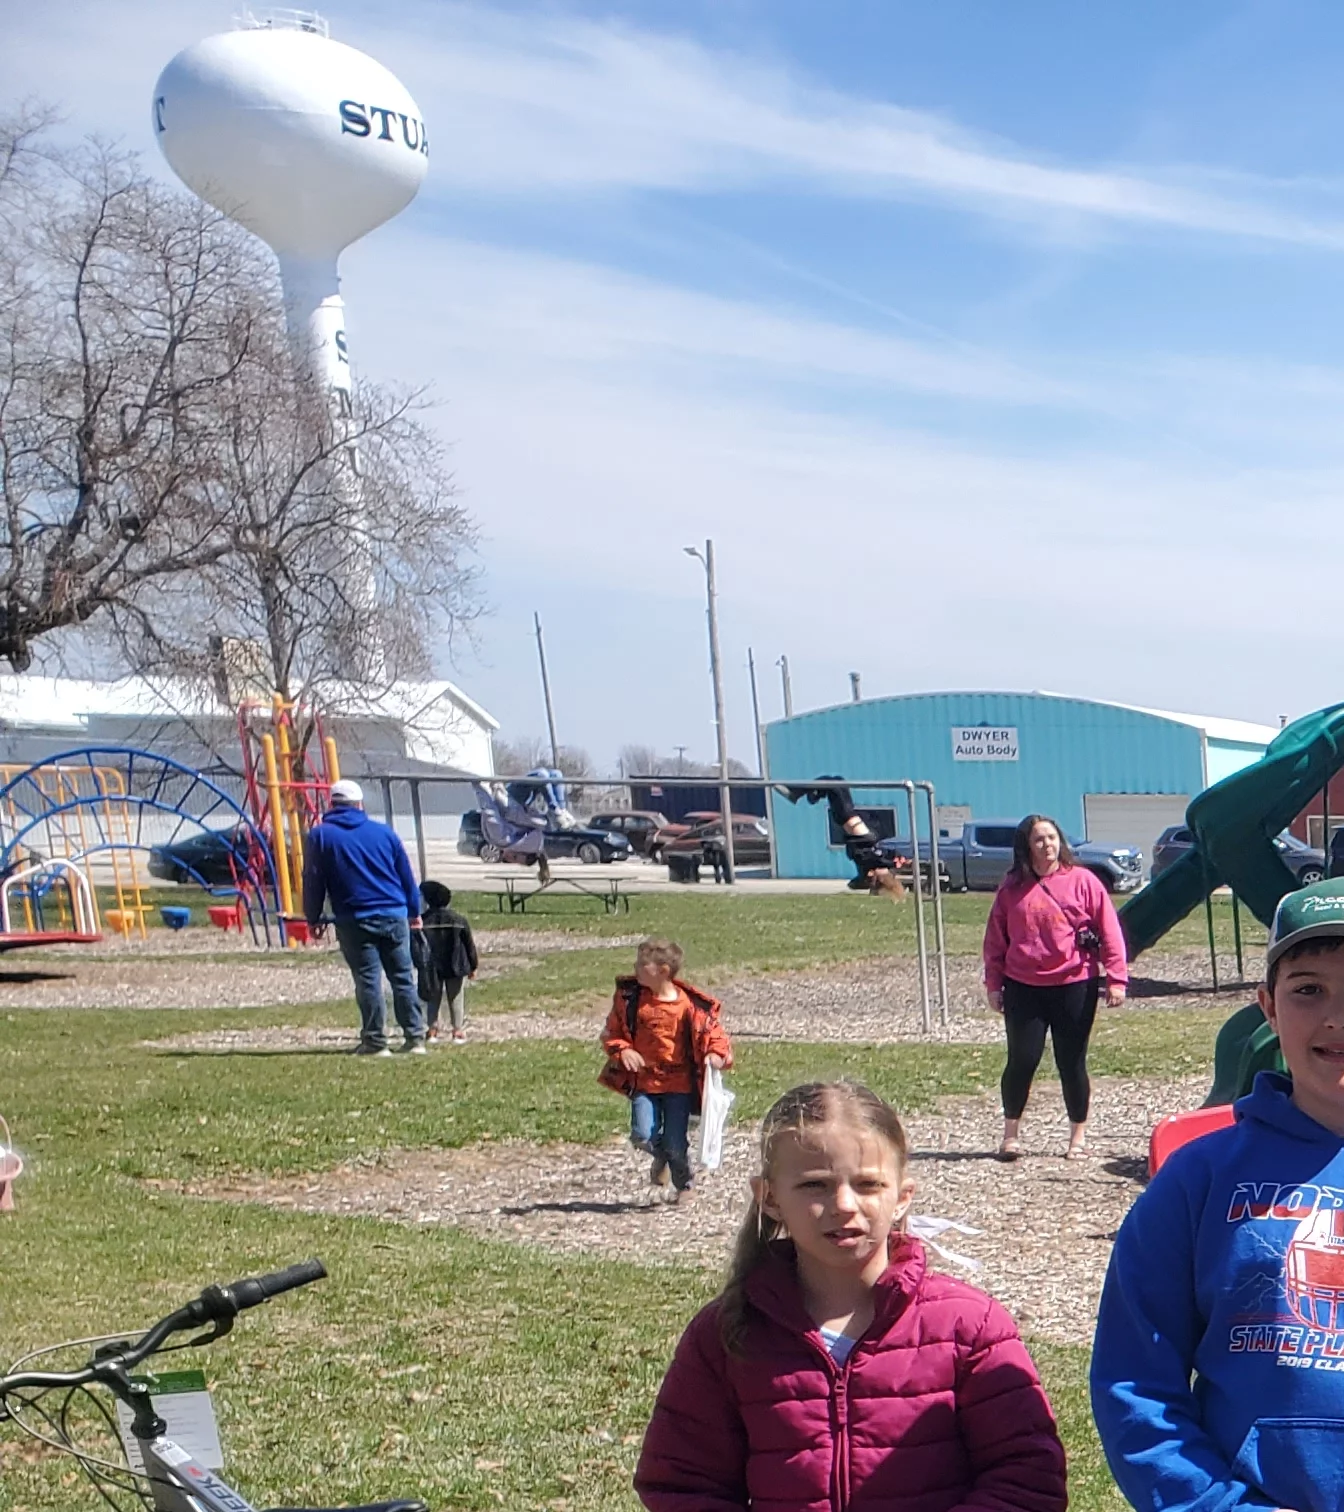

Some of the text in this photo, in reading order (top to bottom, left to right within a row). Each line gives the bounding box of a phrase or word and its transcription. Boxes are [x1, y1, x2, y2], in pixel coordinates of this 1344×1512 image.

[961, 730, 1010, 741] DWYER
[955, 743, 1018, 757] Auto Body
[1229, 1325, 1304, 1353] STATE
[1276, 1355, 1313, 1369] 2019
